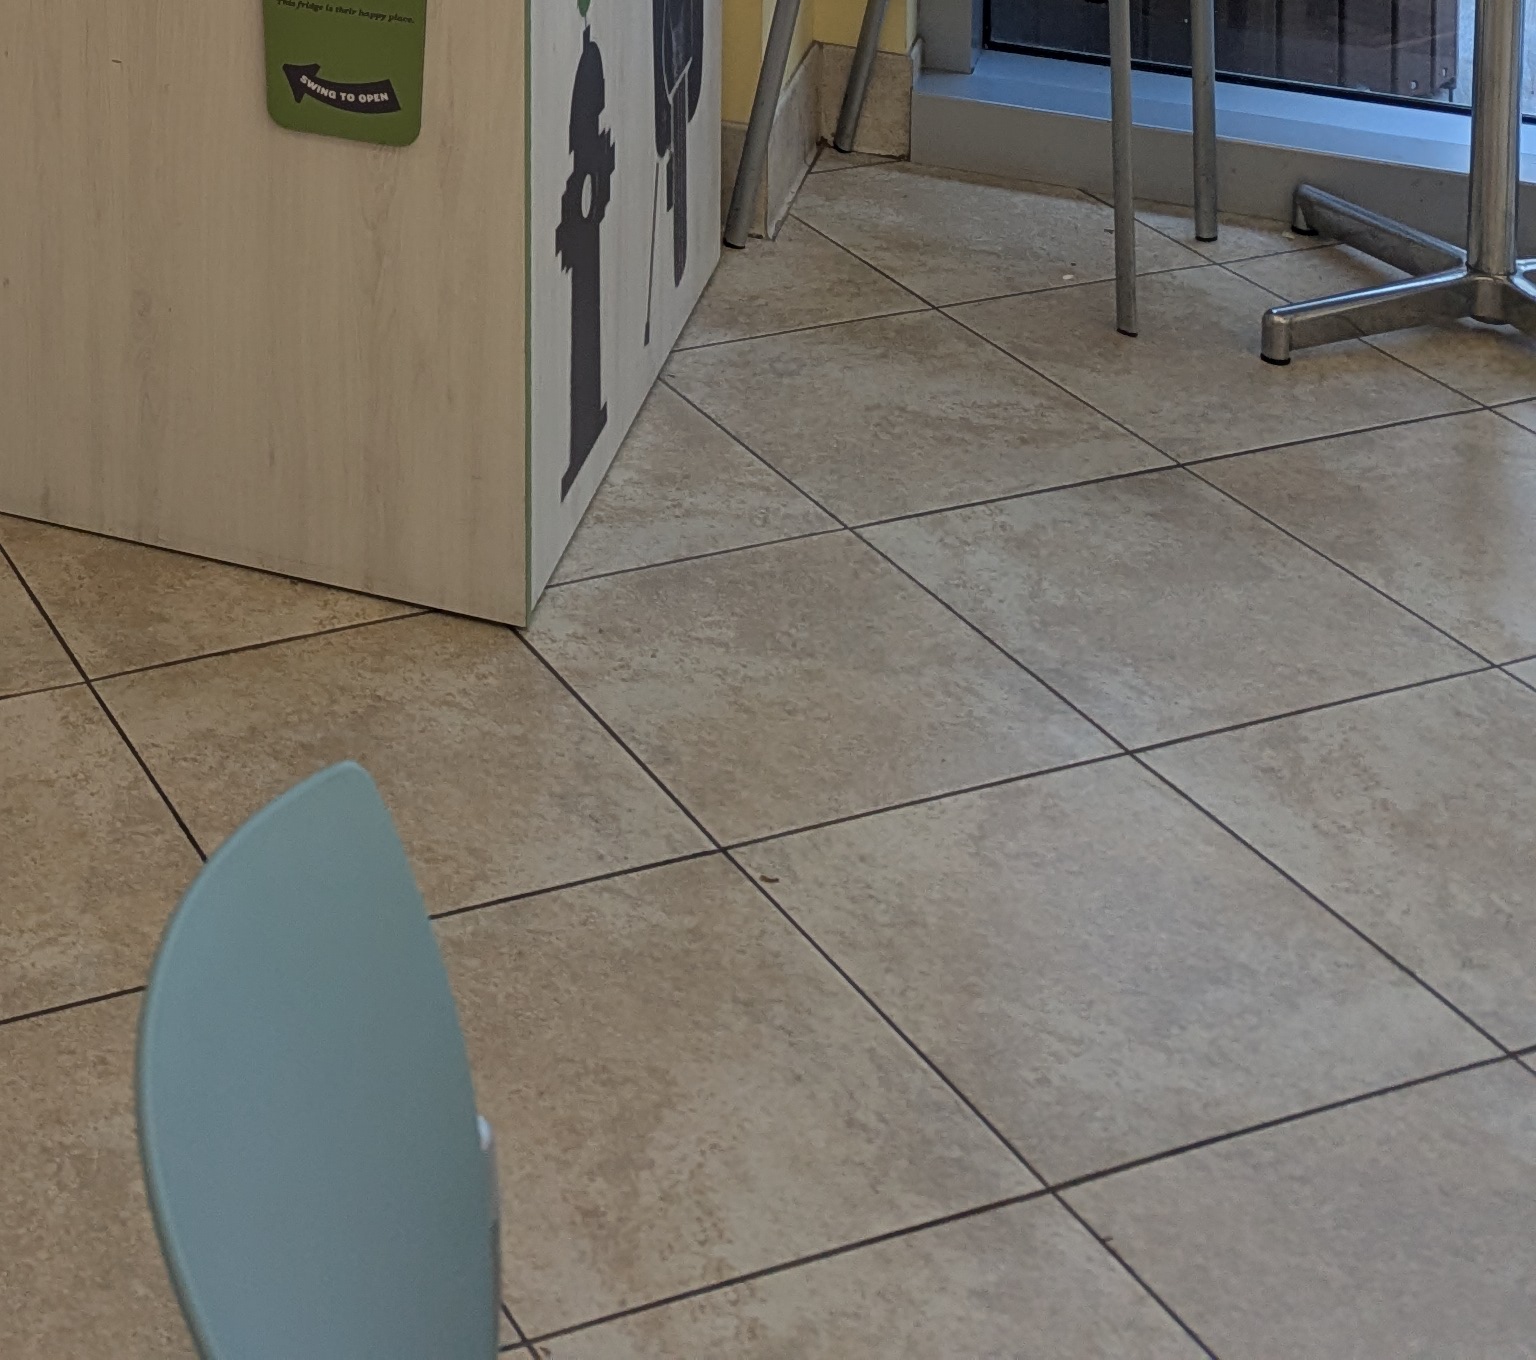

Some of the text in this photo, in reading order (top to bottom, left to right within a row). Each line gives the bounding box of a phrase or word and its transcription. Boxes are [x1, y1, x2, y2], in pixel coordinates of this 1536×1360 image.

[359, 9, 386, 21] happy
[299, 75, 390, 103] SWING TO OPEN
